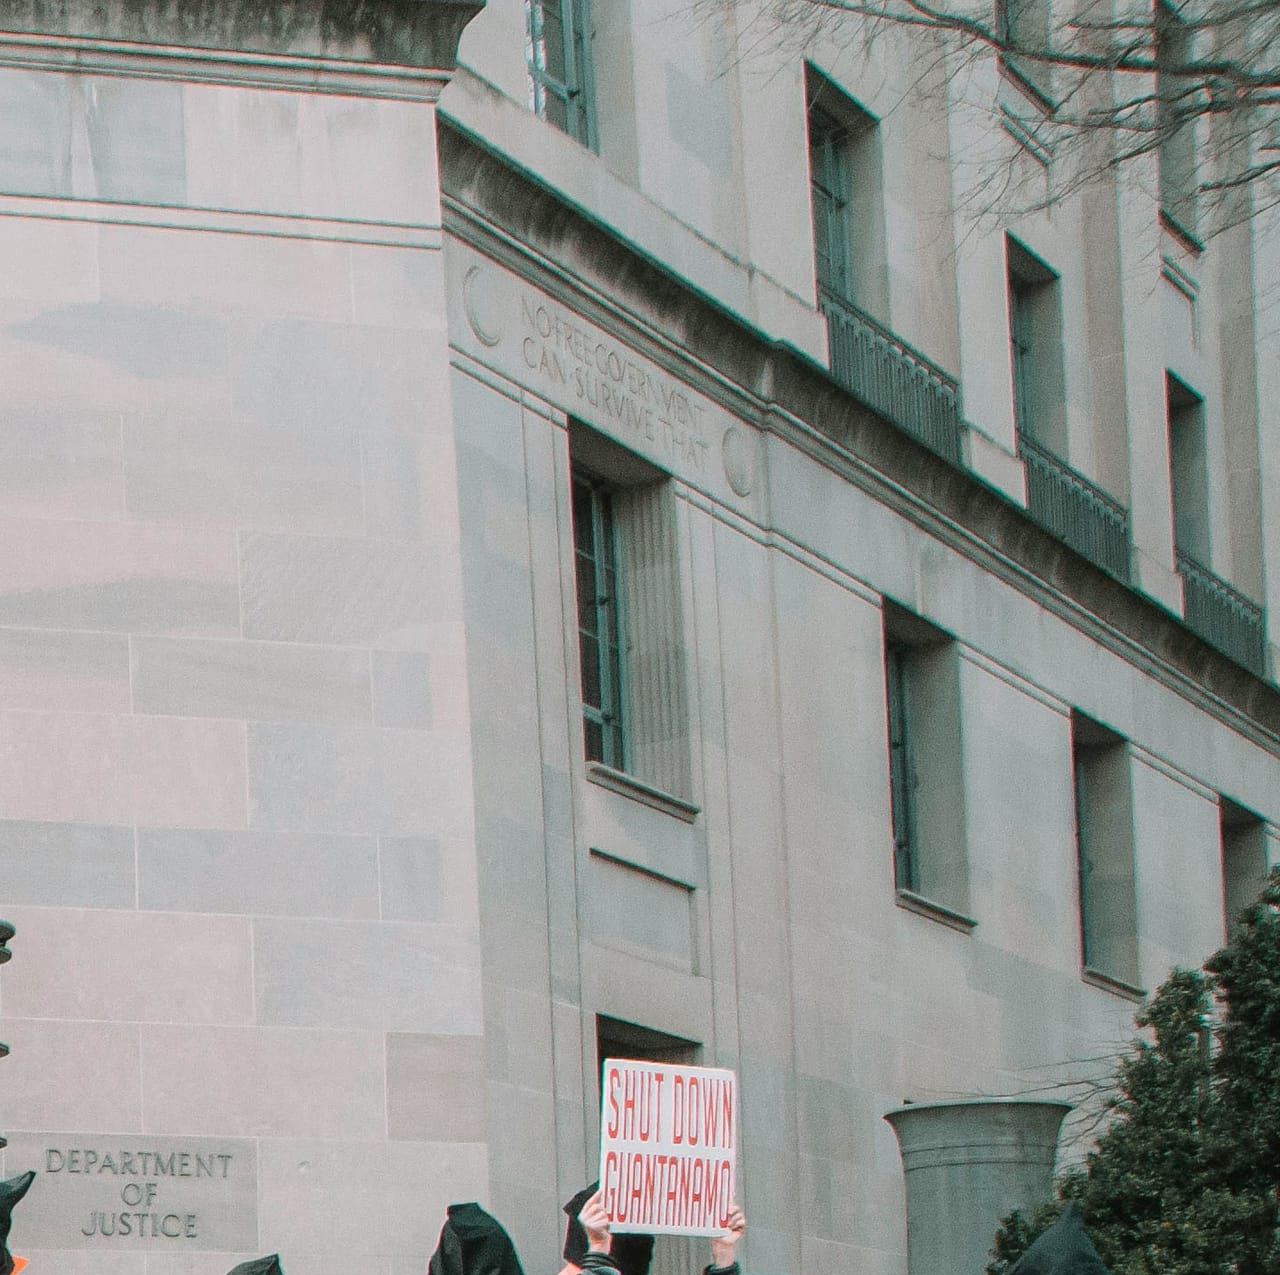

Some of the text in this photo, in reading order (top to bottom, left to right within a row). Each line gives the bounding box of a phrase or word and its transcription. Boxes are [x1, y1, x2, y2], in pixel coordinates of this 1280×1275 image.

[521, 336, 566, 384] CAN
[575, 367, 654, 441] SURVIVE
[595, 343, 706, 434] GOVERNMENT
[608, 1068, 732, 1149] SHUT DOWN
[45, 1148, 233, 1178] DEPARTMENT
[120, 1182, 158, 1207] OF
[604, 1151, 731, 1228] GUANTANAMO
[81, 1211, 197, 1238] JUSTICE
